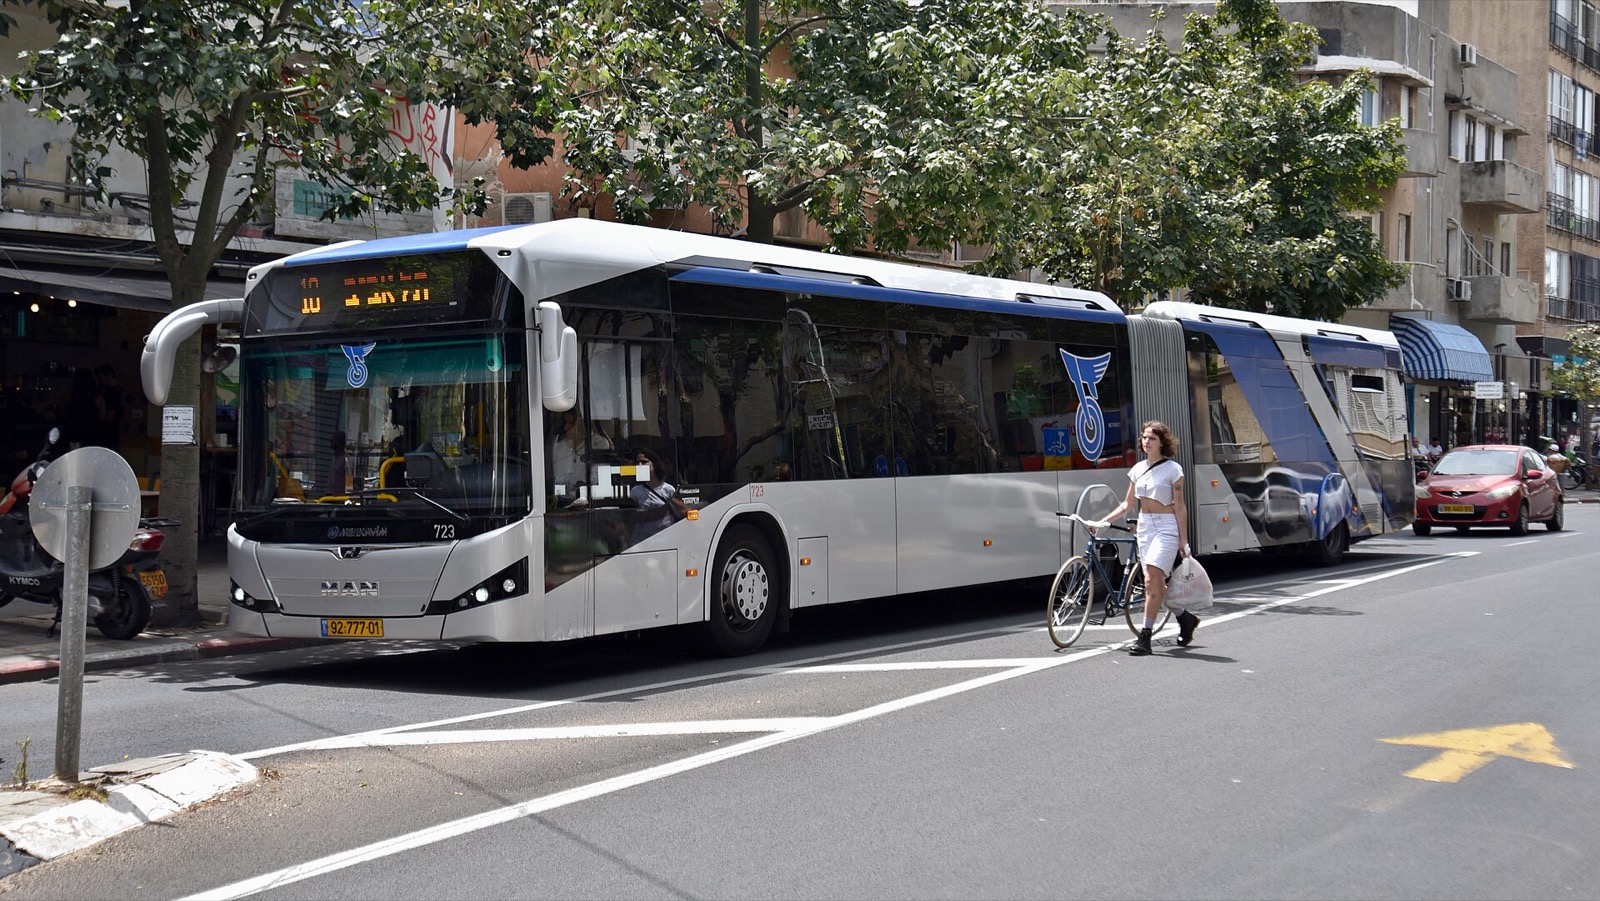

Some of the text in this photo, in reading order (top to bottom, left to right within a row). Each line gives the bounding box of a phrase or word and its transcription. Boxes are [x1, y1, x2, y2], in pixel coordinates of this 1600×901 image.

[751, 485, 764, 498] 723
[434, 525, 455, 539] 723
[9, 576, 41, 586] KYMCO
[321, 581, 380, 597] MAN
